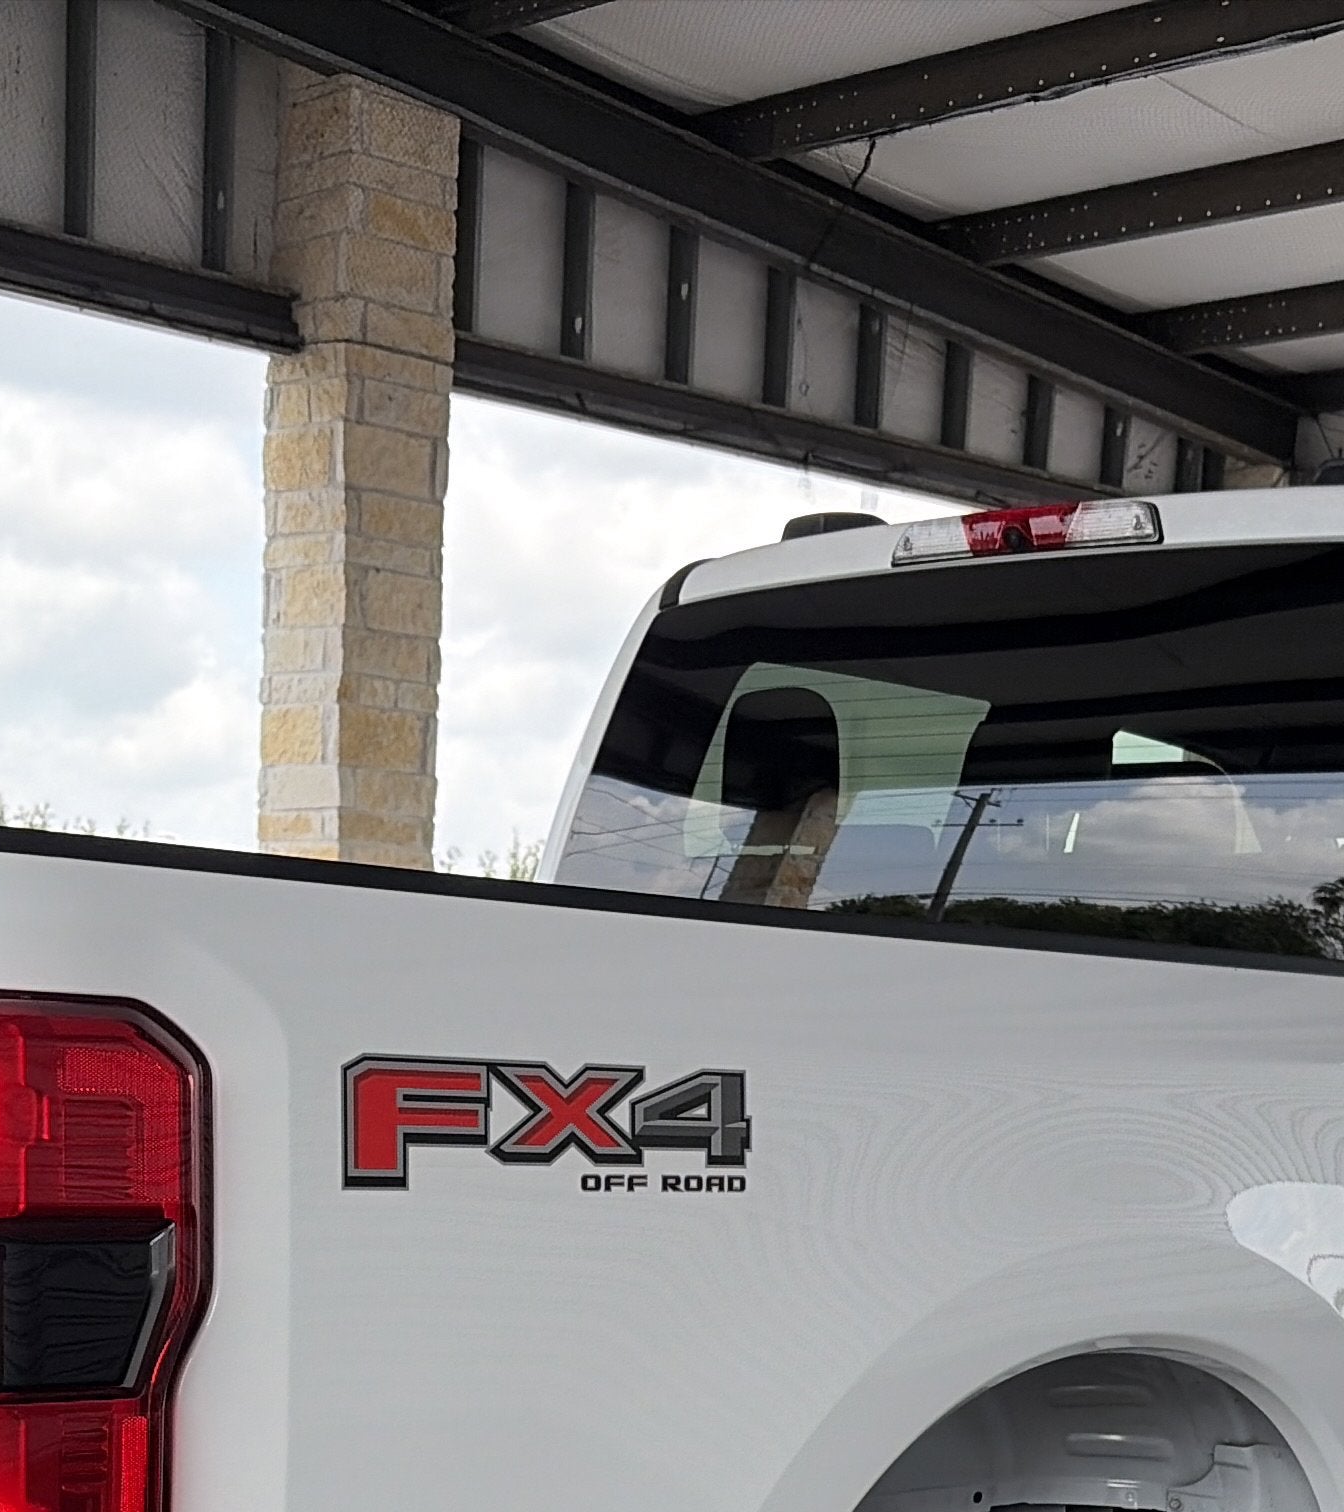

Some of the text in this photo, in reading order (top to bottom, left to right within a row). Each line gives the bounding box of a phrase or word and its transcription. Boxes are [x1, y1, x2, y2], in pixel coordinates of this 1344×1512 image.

[340, 1052, 752, 1191] FX4
[581, 1174, 747, 1193] OFF ROAD
